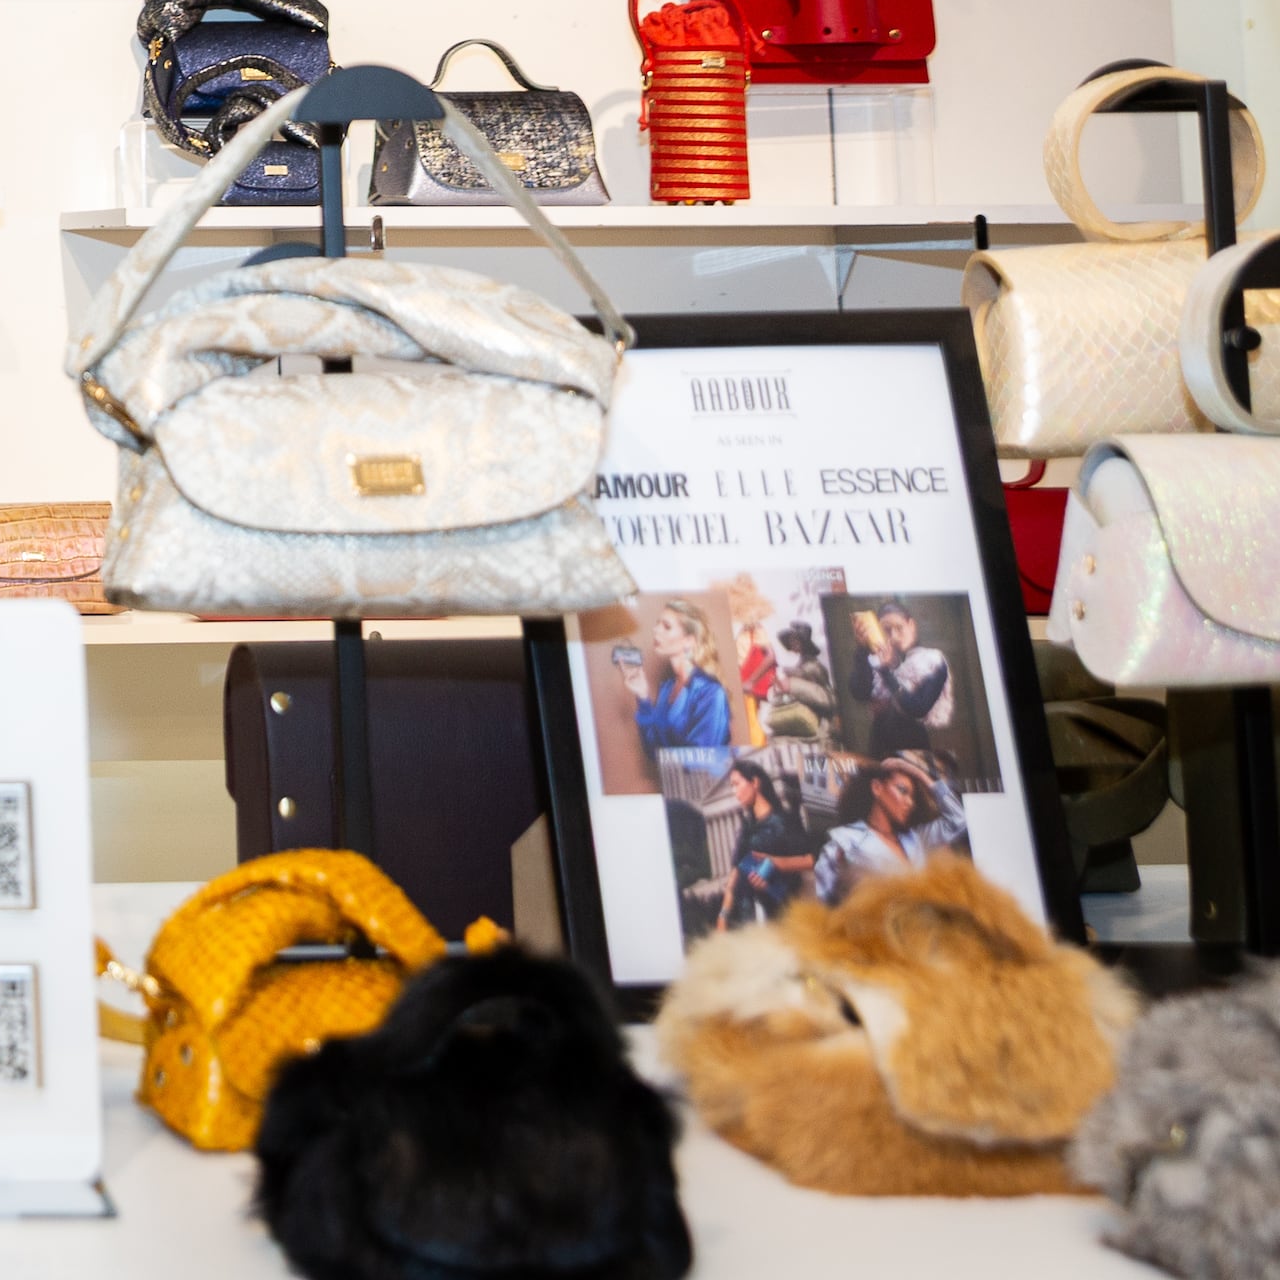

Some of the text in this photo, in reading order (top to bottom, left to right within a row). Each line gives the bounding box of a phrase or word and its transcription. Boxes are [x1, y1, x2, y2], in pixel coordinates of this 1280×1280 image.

[690, 376, 791, 412] AABOUX
[592, 467, 950, 499] AMOUR ELLE ESSENCE
[763, 506, 915, 546] BAZAAR
